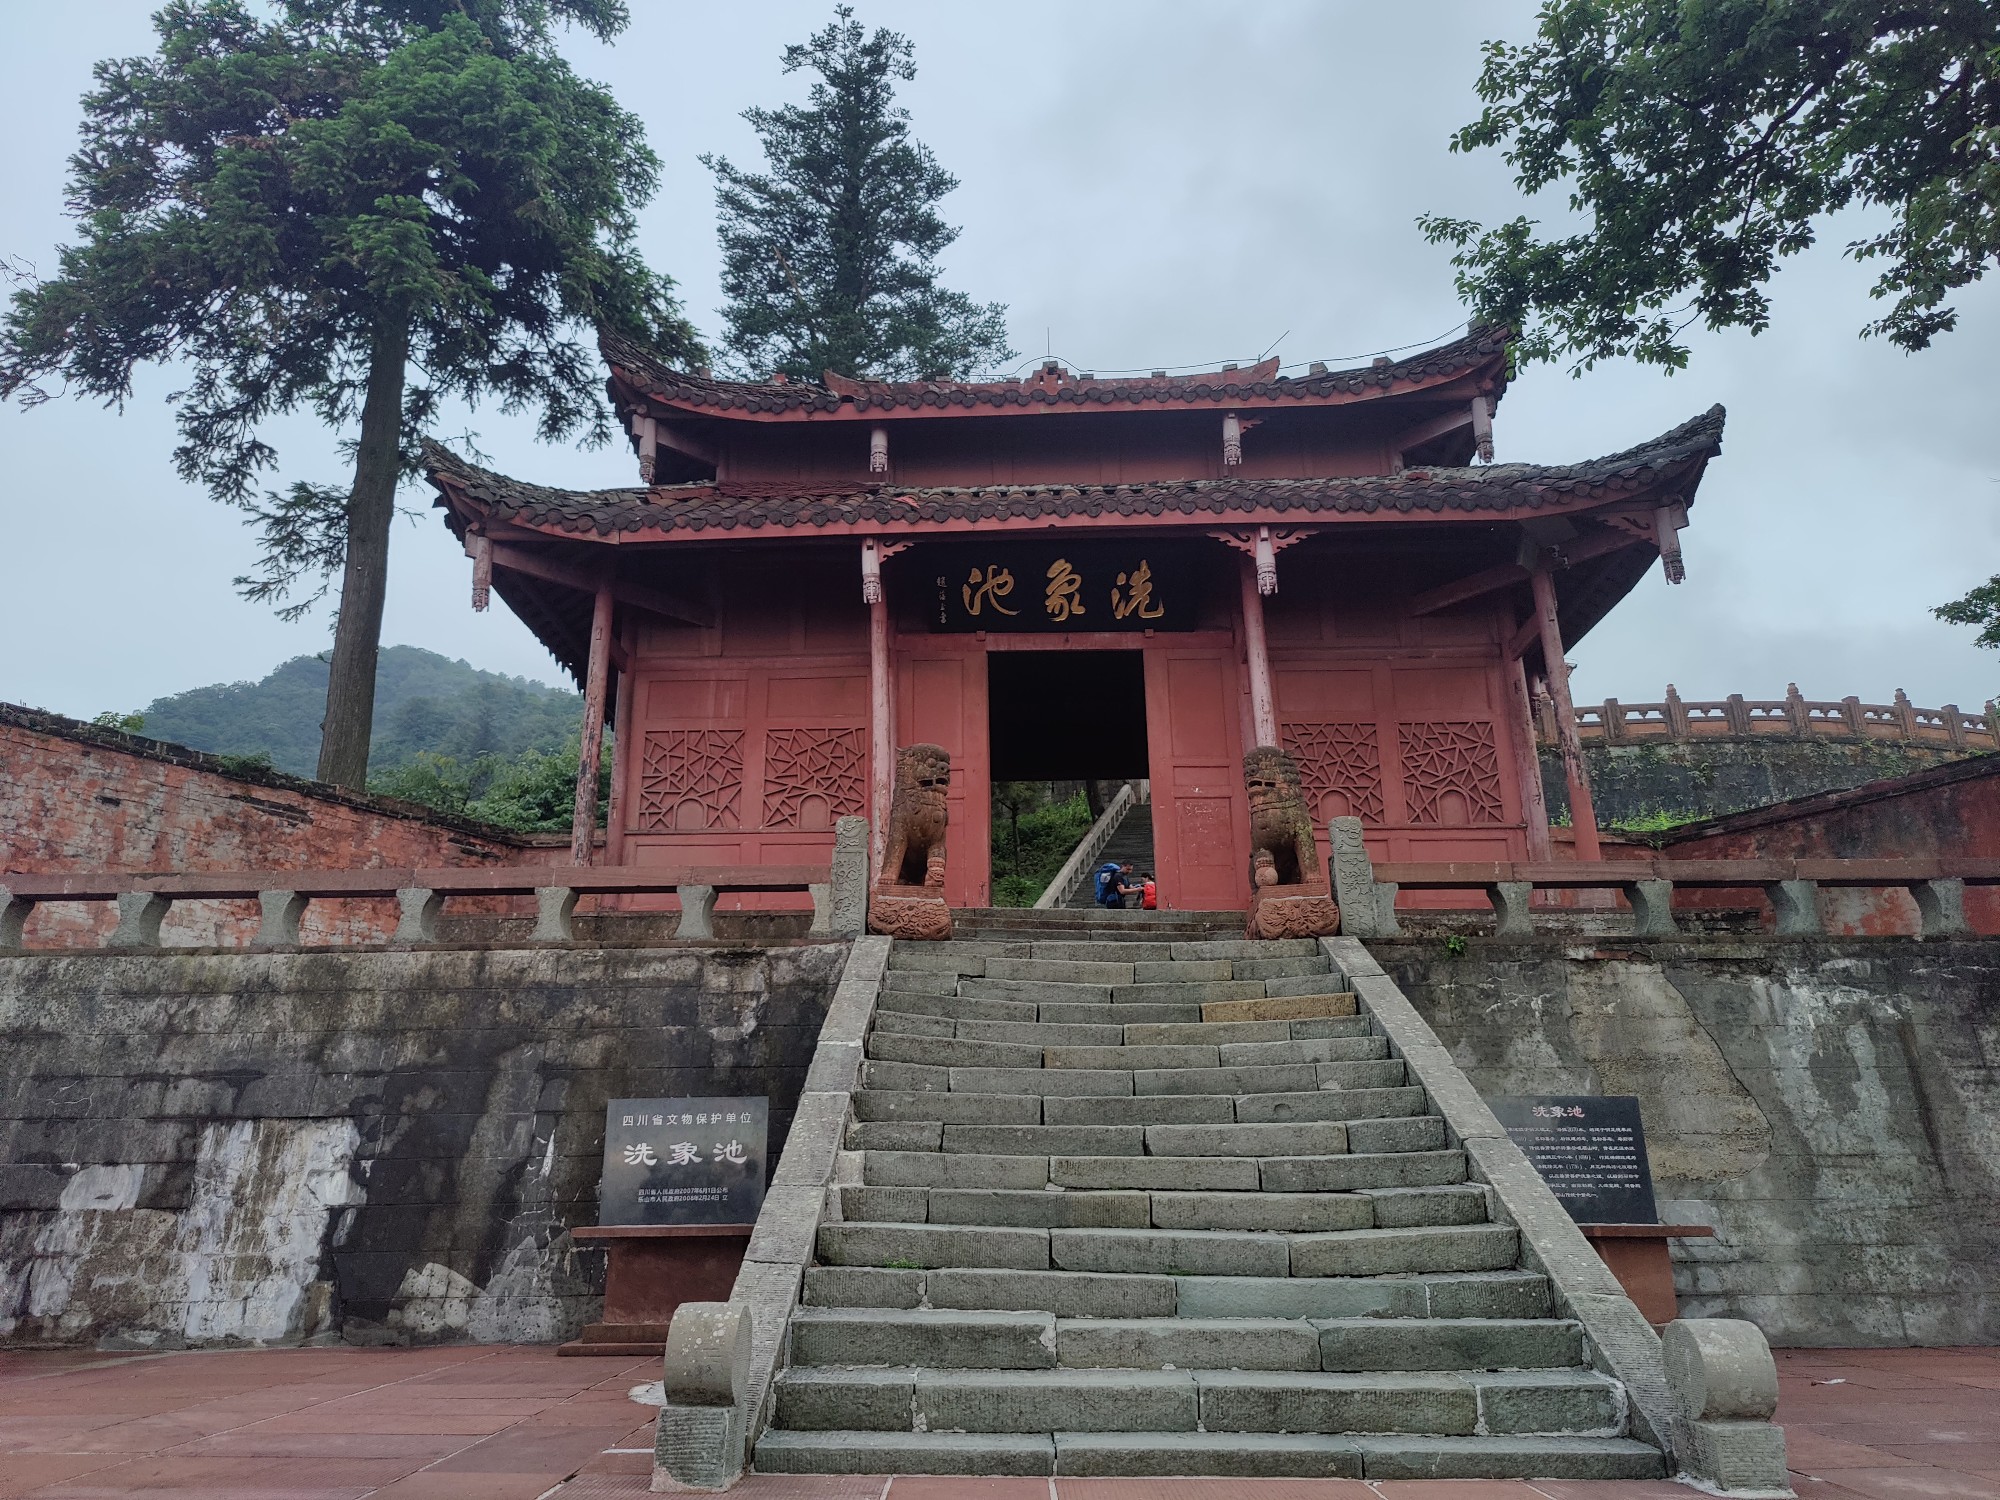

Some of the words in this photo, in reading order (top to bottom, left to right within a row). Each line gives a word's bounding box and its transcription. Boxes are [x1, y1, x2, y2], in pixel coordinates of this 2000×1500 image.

[1532, 1105, 1585, 1118] 洗象池
[622, 1112, 752, 1127] 四川省文物保护单位
[623, 1140, 748, 1166] 洗象池
